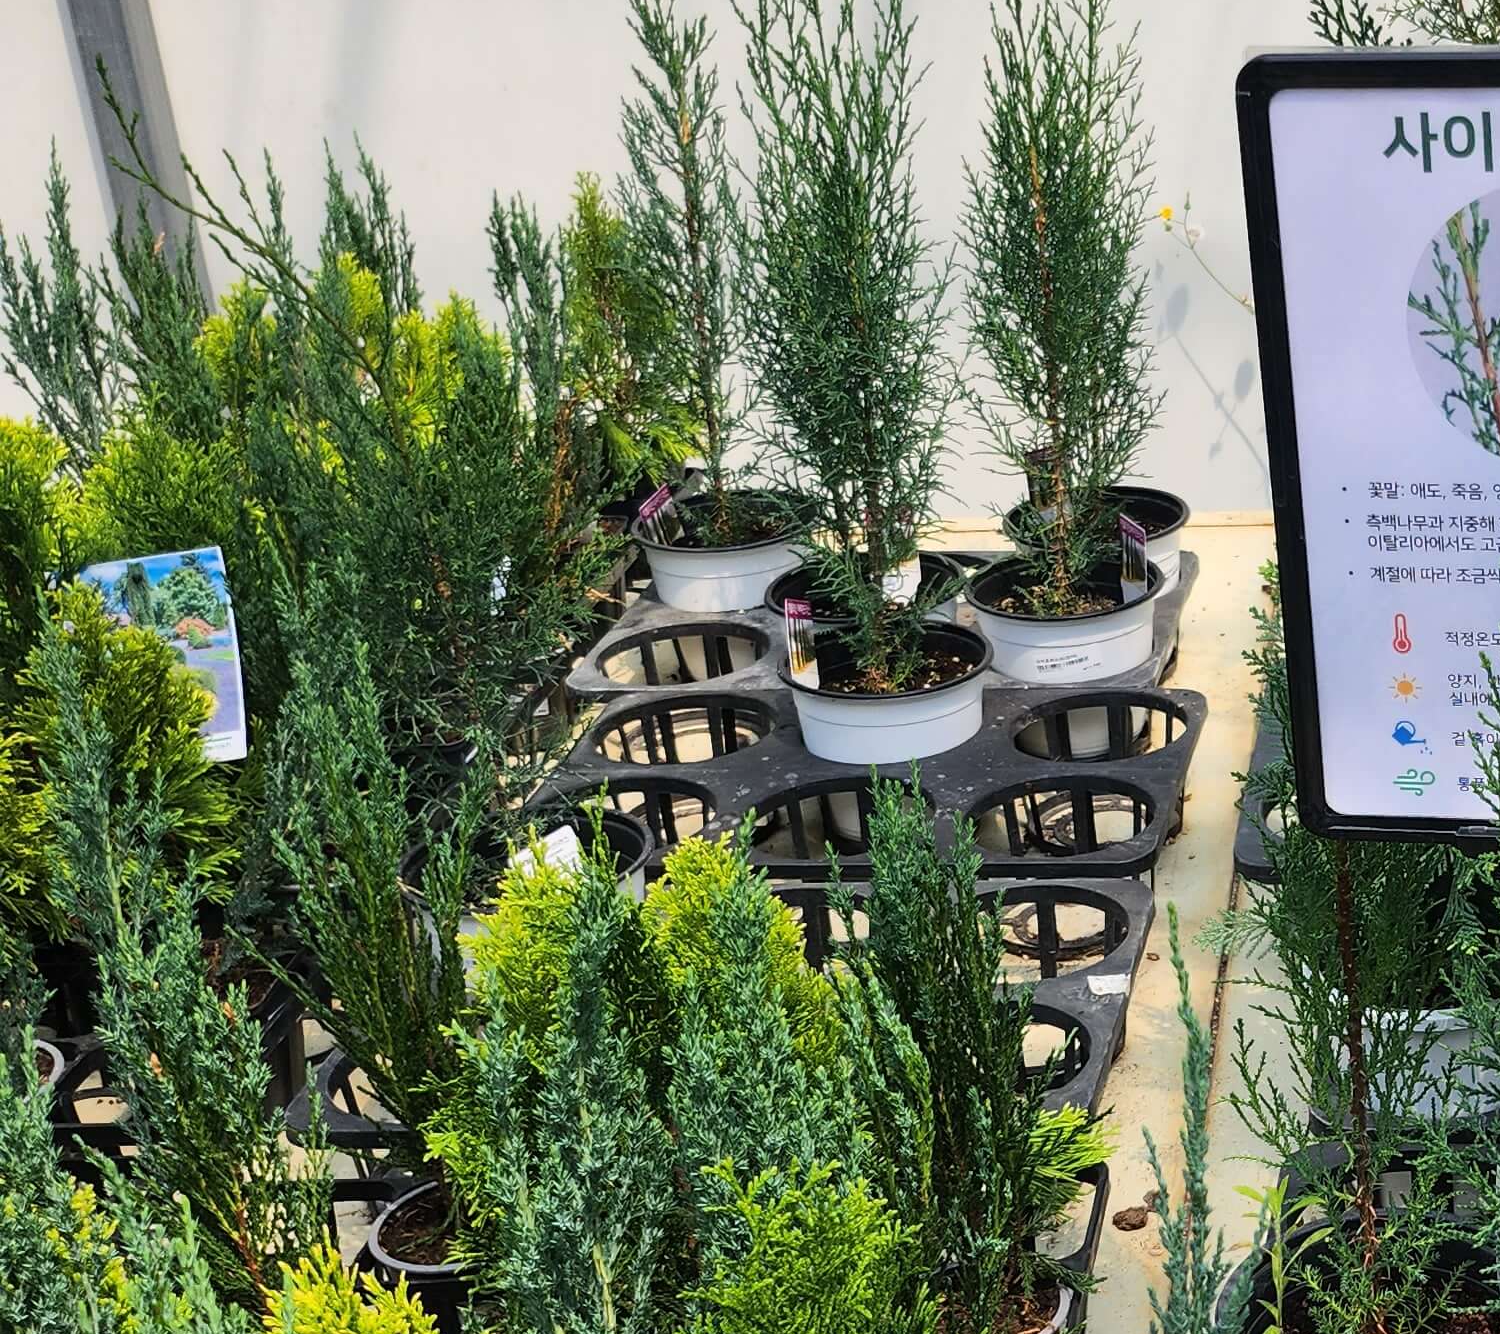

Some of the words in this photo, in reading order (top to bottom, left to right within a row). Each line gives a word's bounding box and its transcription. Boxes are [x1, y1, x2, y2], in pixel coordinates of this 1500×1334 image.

[1368, 481, 1405, 500] 꽃말:
[1410, 482, 1446, 501] 애도,
[1451, 483, 1487, 502] 죽음,
[1366, 514, 1444, 533] 측백나무과
[1448, 515, 1495, 534] 지중해
[1367, 534, 1477, 554] 이탈리아에서도
[1370, 565, 1416, 584] 계절에
[1420, 566, 1451, 584] 따라
[1447, 673, 1482, 690] 양지,
